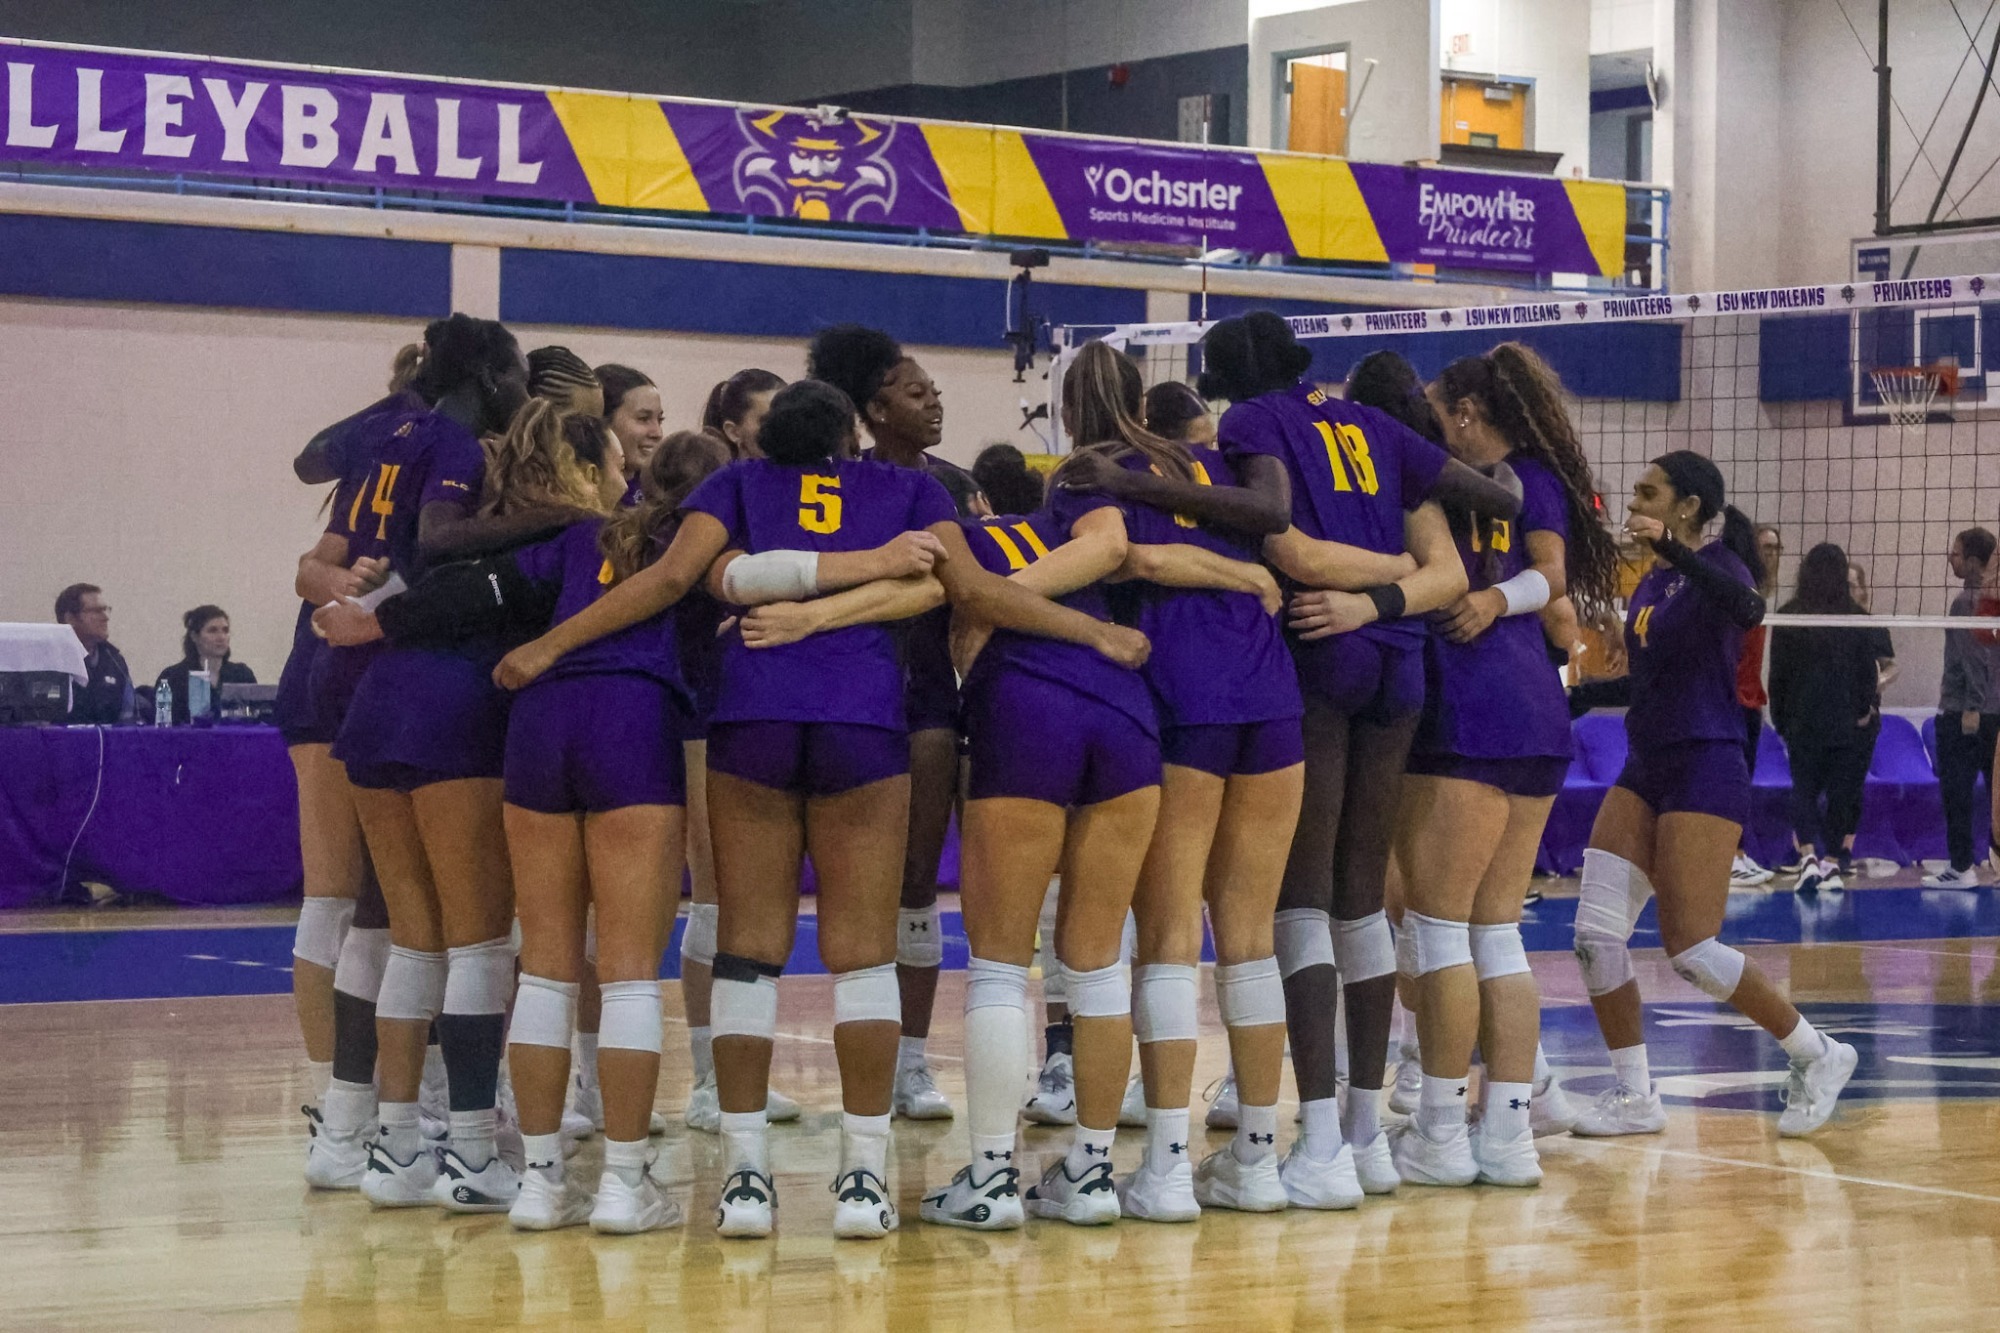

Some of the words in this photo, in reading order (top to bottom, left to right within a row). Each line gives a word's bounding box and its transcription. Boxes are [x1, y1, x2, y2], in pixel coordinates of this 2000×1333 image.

[1104, 167, 1243, 211] Ochsner
[1089, 207, 1129, 223] Sports
[1131, 210, 1186, 227] Medicine
[1717, 293, 1739, 312] LSU
[1740, 290, 1768, 310] NEW
[1770, 287, 1825, 308] ORLEANS
[1873, 279, 1952, 302] PRIVATEERS
[1466, 308, 1486, 326] LSU
[1487, 307, 1511, 325] NEW
[1513, 303, 1561, 324] ORLEANS
[1603, 297, 1672, 318] PRIVATEERS
[1365, 311, 1427, 331] PRIVATEERS
[349, 463, 401, 541] 14
[798, 473, 842, 535] 5
[983, 520, 1051, 570] 11
[1633, 605, 1655, 648] 4
